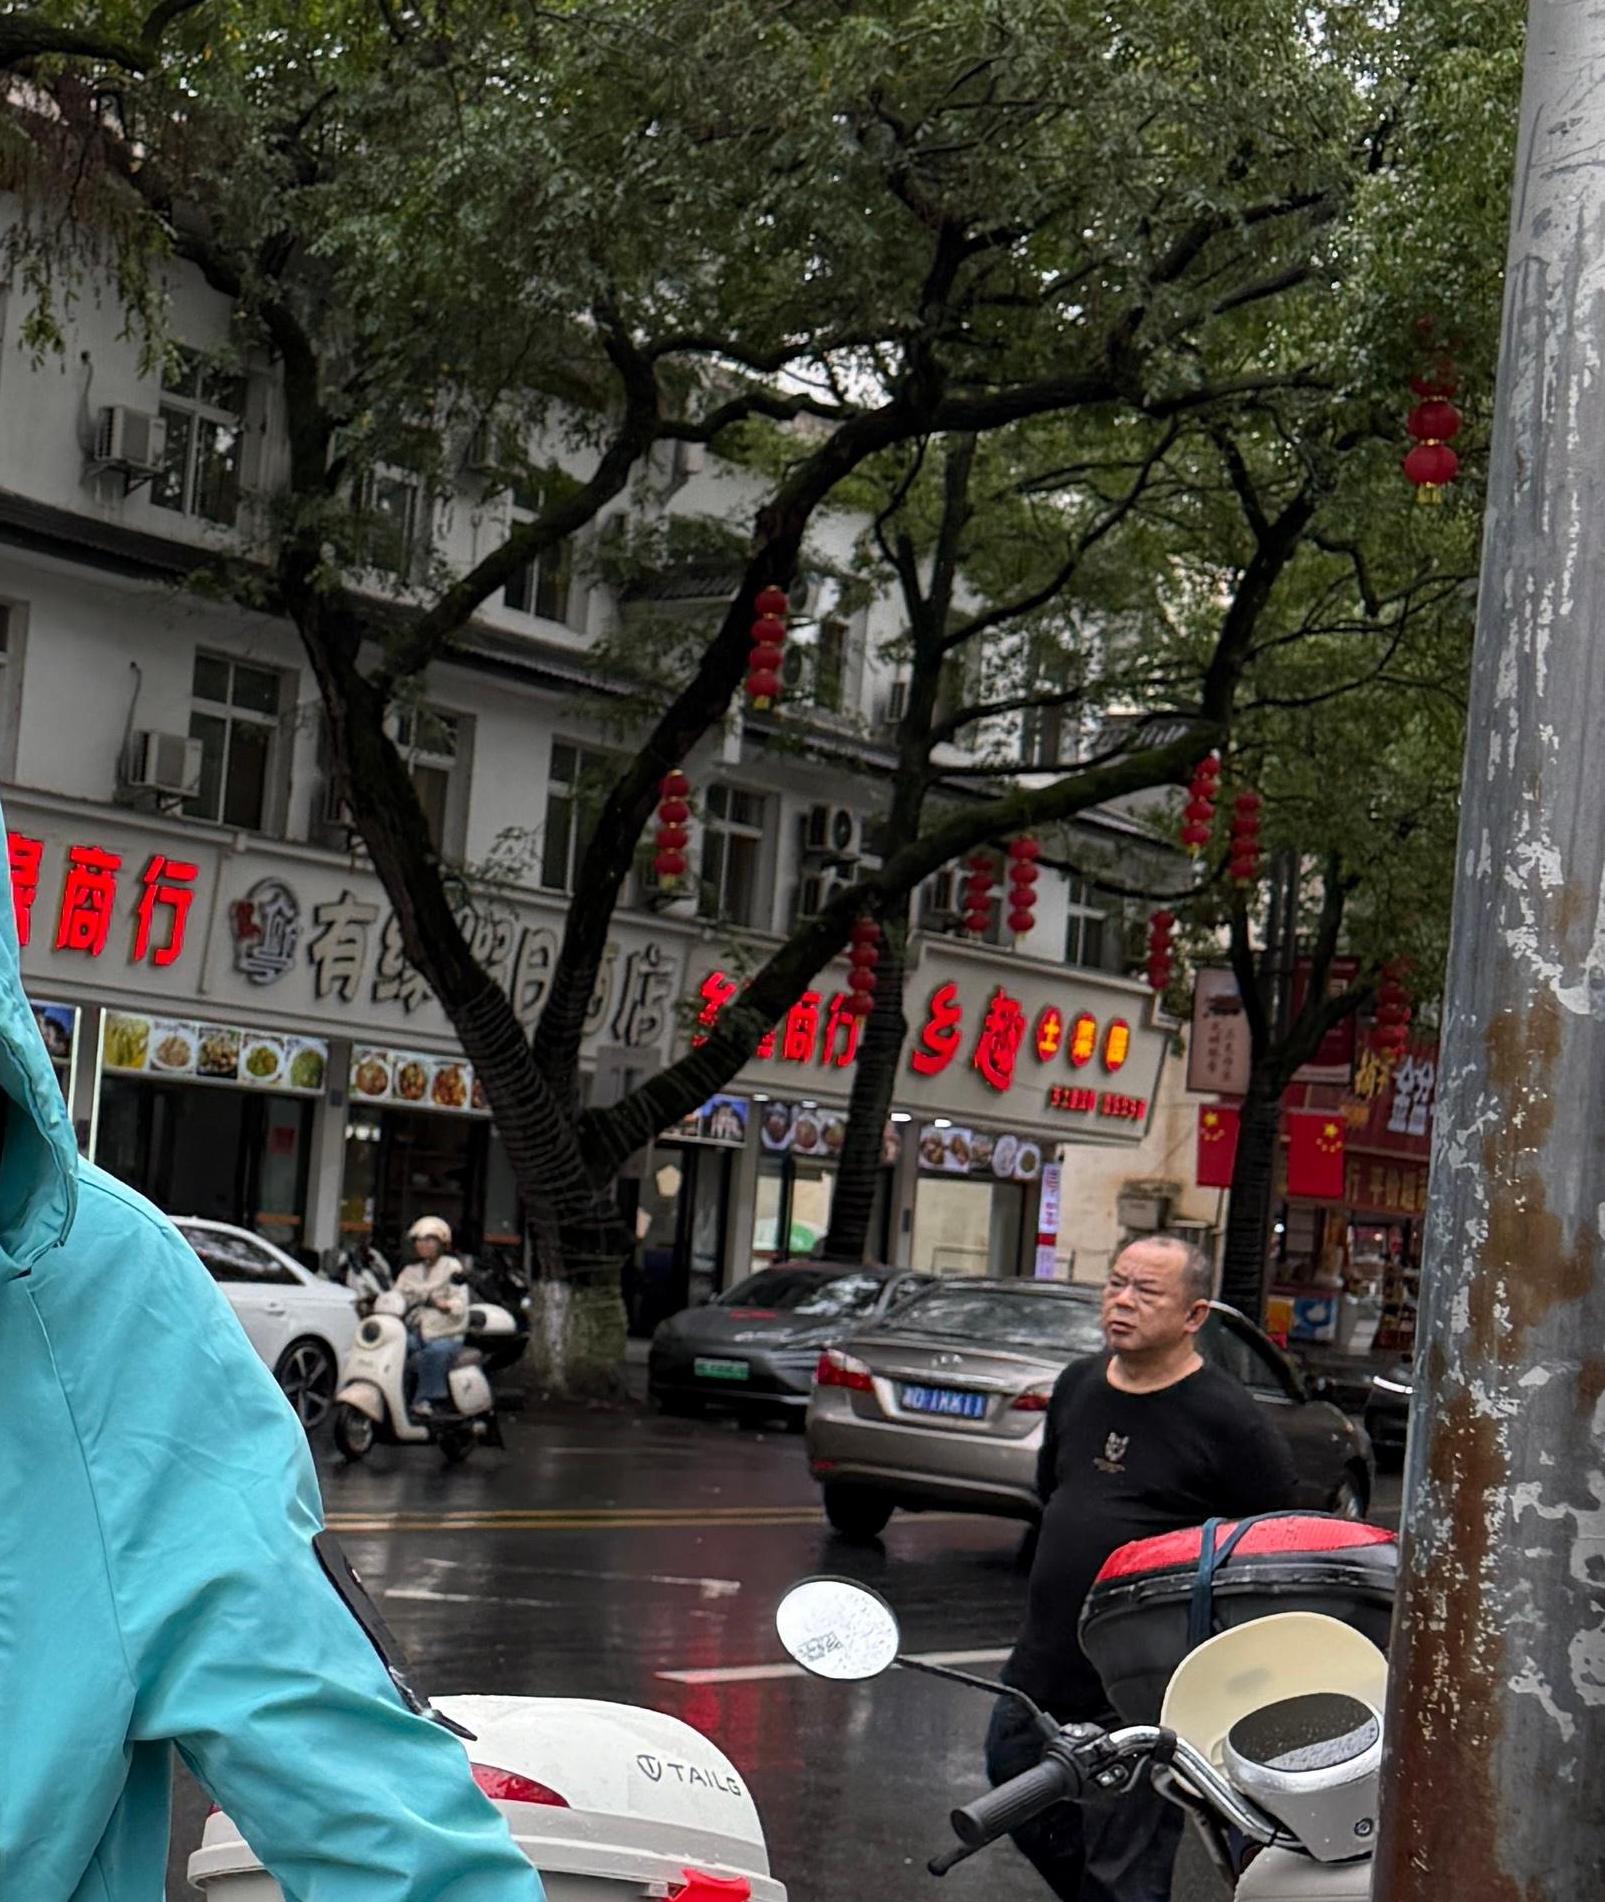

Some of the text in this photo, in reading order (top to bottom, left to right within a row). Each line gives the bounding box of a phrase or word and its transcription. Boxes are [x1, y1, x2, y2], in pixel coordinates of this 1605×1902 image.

[692, 971, 858, 1067] 乡商行
[667, 1763, 741, 1796] TAILG
